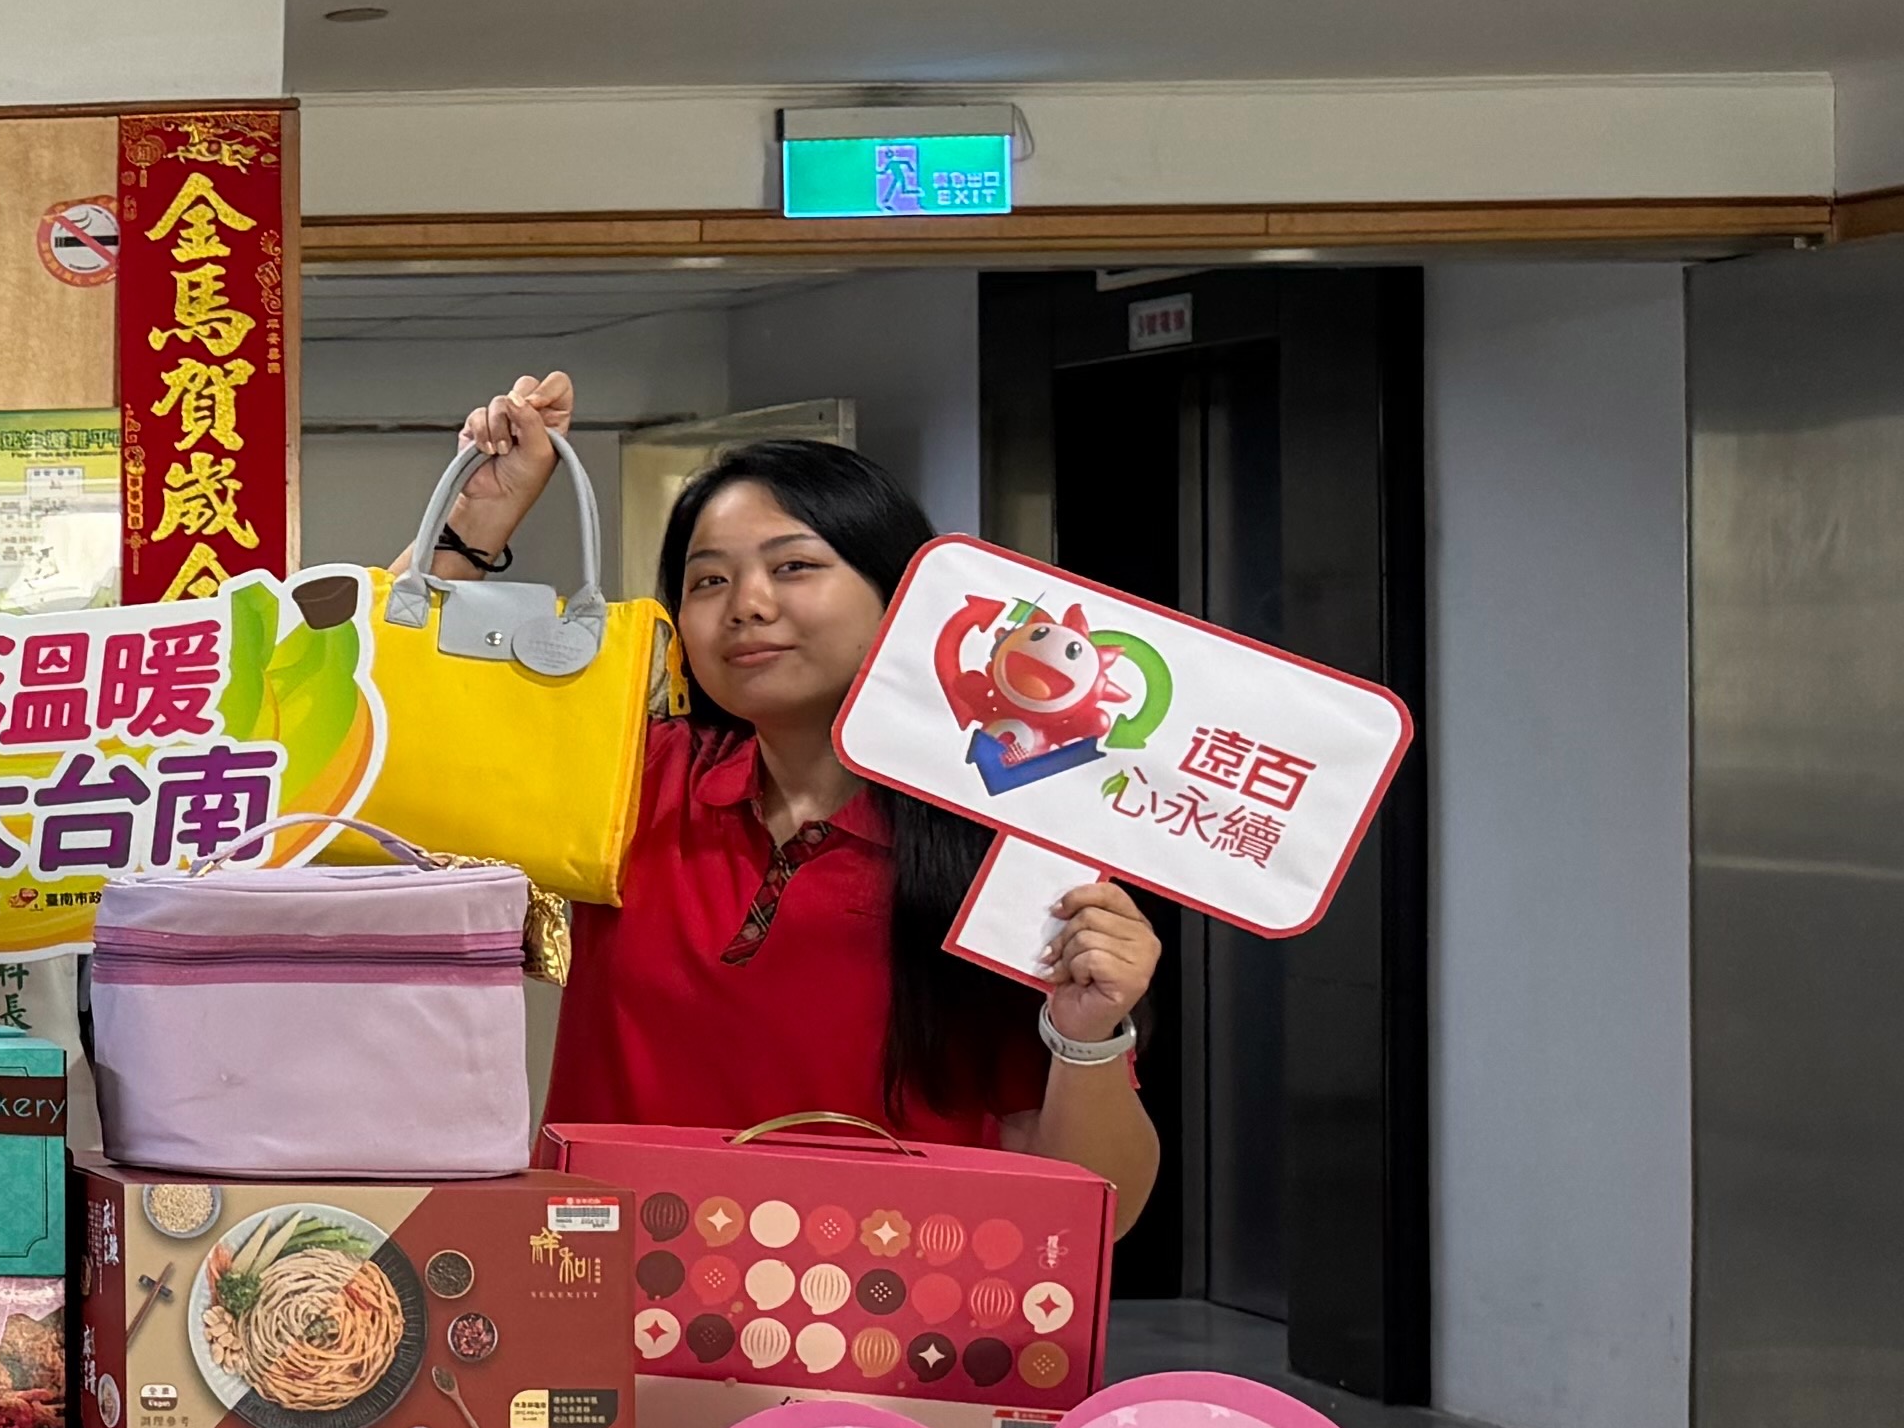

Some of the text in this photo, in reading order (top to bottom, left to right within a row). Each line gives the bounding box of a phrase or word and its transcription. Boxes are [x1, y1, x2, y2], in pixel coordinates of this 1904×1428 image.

[937, 189, 996, 205] EXIT
[1179, 727, 1315, 812] 遠百
[1109, 766, 1286, 869] 心永續
[45, 891, 103, 907] 臺南市政
[530, 1227, 585, 1284] 祥和
[531, 1291, 599, 1299] SERENITY
